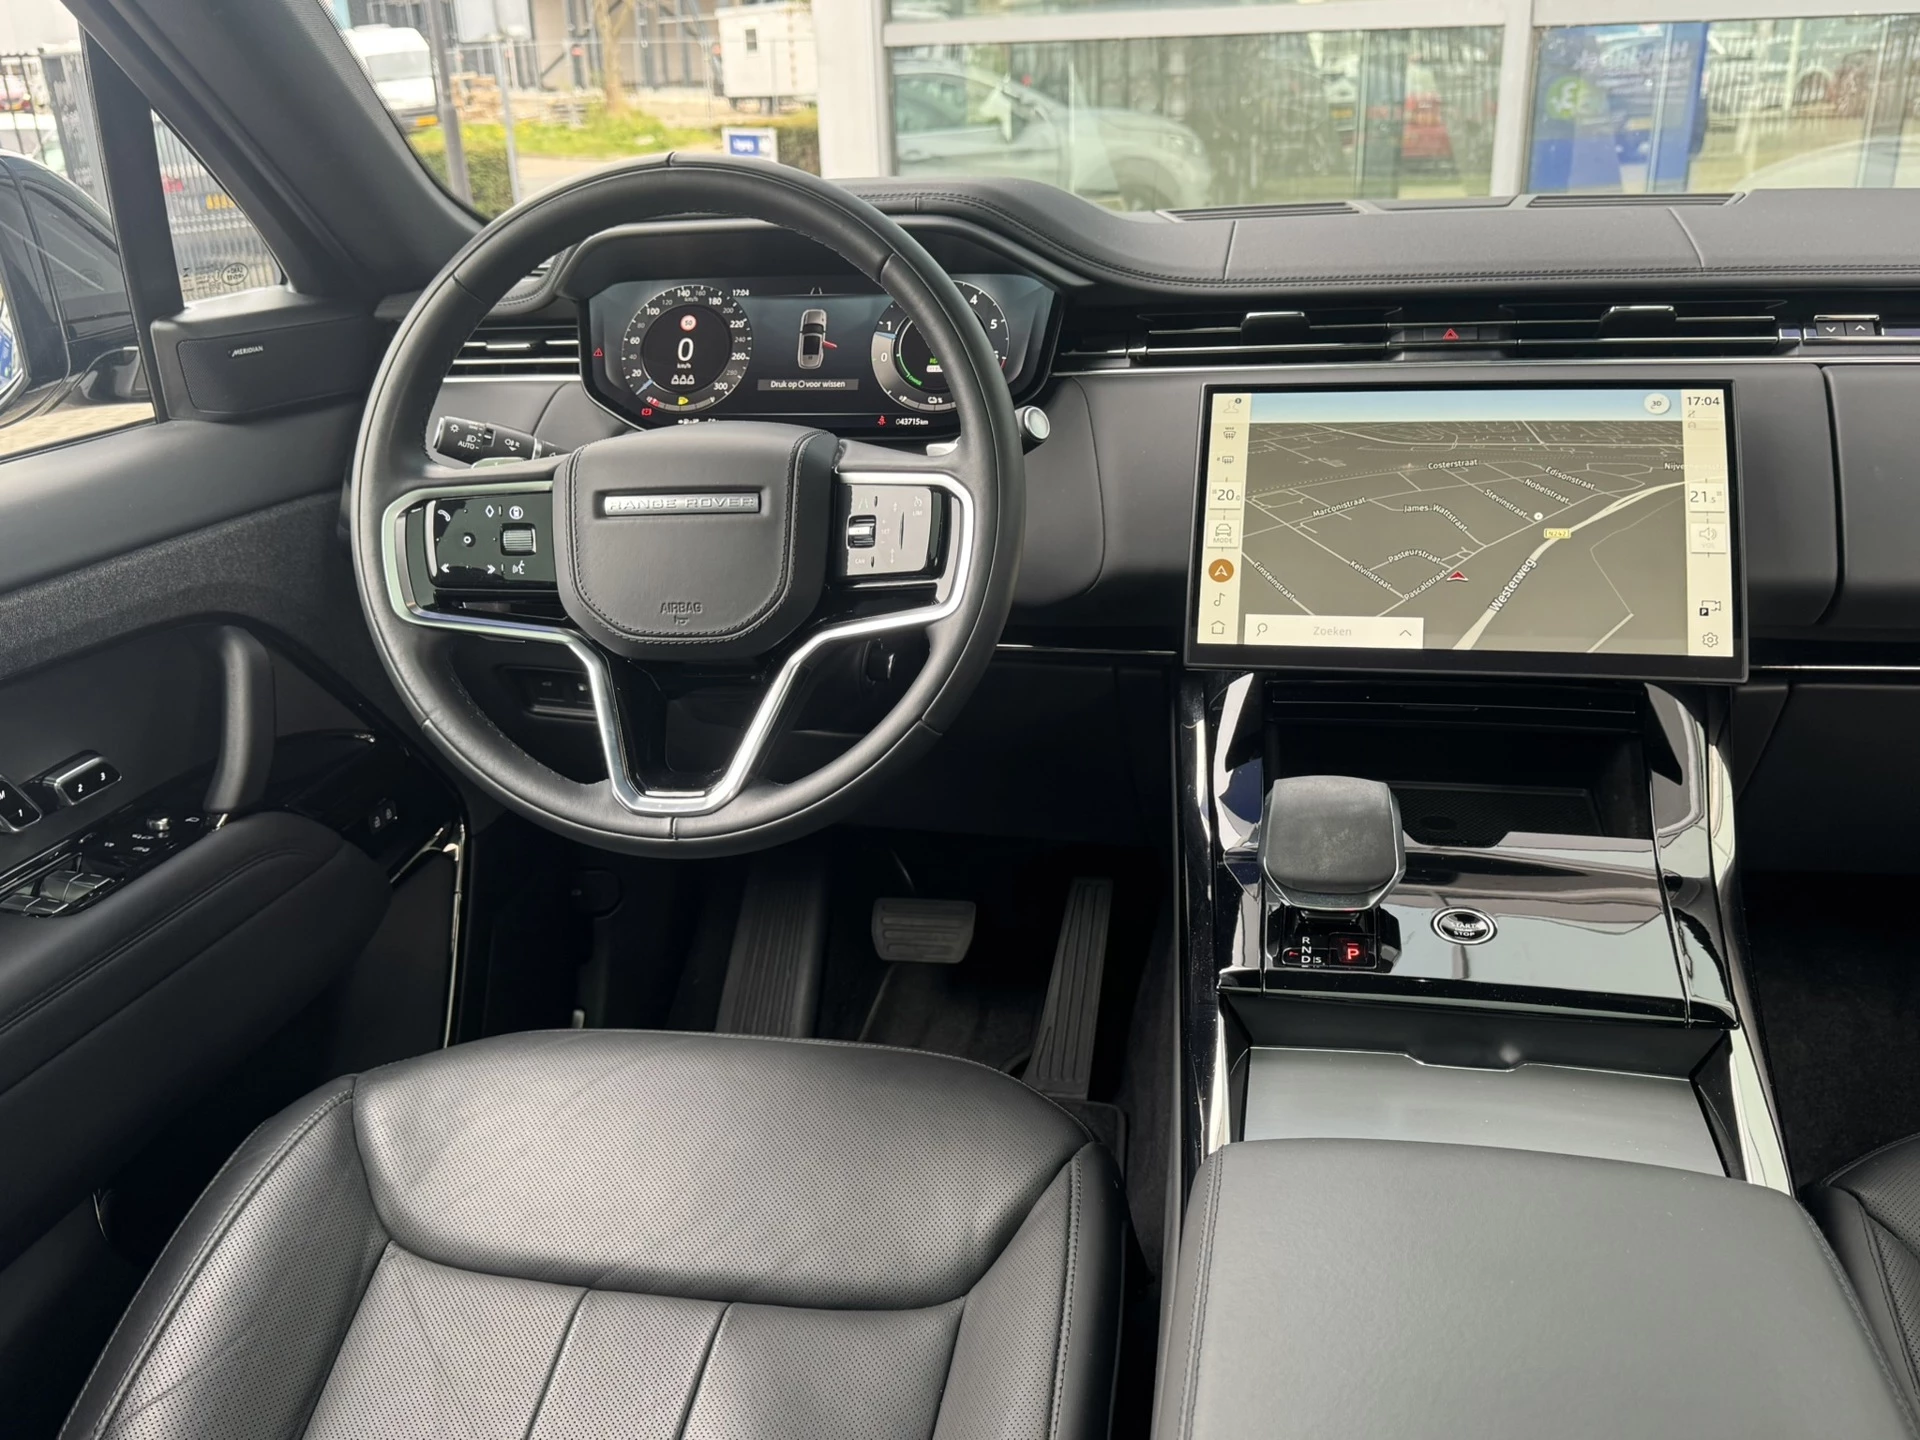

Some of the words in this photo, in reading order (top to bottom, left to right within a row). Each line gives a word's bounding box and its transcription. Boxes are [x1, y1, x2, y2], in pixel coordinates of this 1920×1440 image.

[732, 289, 749, 297] 17:04
[969, 294, 978, 305] 4
[886, 321, 892, 331] 1
[990, 319, 998, 329] 5
[630, 337, 640, 345] 60
[231, 345, 264, 357] MERIDIAN
[677, 338, 694, 362] 0
[731, 352, 746, 360] 260
[881, 353, 888, 362] 0
[631, 369, 641, 377] 20
[713, 382, 728, 390] 300
[770, 380, 787, 388] Druk
[788, 381, 798, 389] op
[822, 380, 846, 388] wissen
[1686, 396, 1720, 406] 17:04
[457, 440, 475, 450] AUTO
[1427, 459, 1478, 470] Costerstraat
[1545, 466, 1596, 490] Edisonstraat
[1524, 478, 1570, 505] Nobelstraat
[609, 499, 678, 511] RANGE
[685, 496, 755, 509] ROVER
[1312, 497, 1366, 518] Marconistraat
[1484, 488, 1528, 519] Stevinstraat
[1404, 504, 1429, 513] James
[1432, 504, 1468, 532] Wattstraat
[1387, 549, 1441, 564] Pasteurstraat
[1350, 560, 1392, 590] Kelvinstraat
[1253, 561, 1295, 601] Einsteinstraat
[1403, 569, 1448, 601] Pascalstraat
[1489, 558, 1537, 612] Westerweg
[660, 602, 703, 614] AIRBAG
[1313, 626, 1352, 636] Zoeken
[100, 772, 106, 781] 3
[77, 783, 83, 793] 2
[18, 809, 23, 817] 1
[1302, 936, 1311, 945] R
[1301, 945, 1312, 954] N
[1347, 948, 1360, 960] P
[1301, 955, 1311, 964] D
